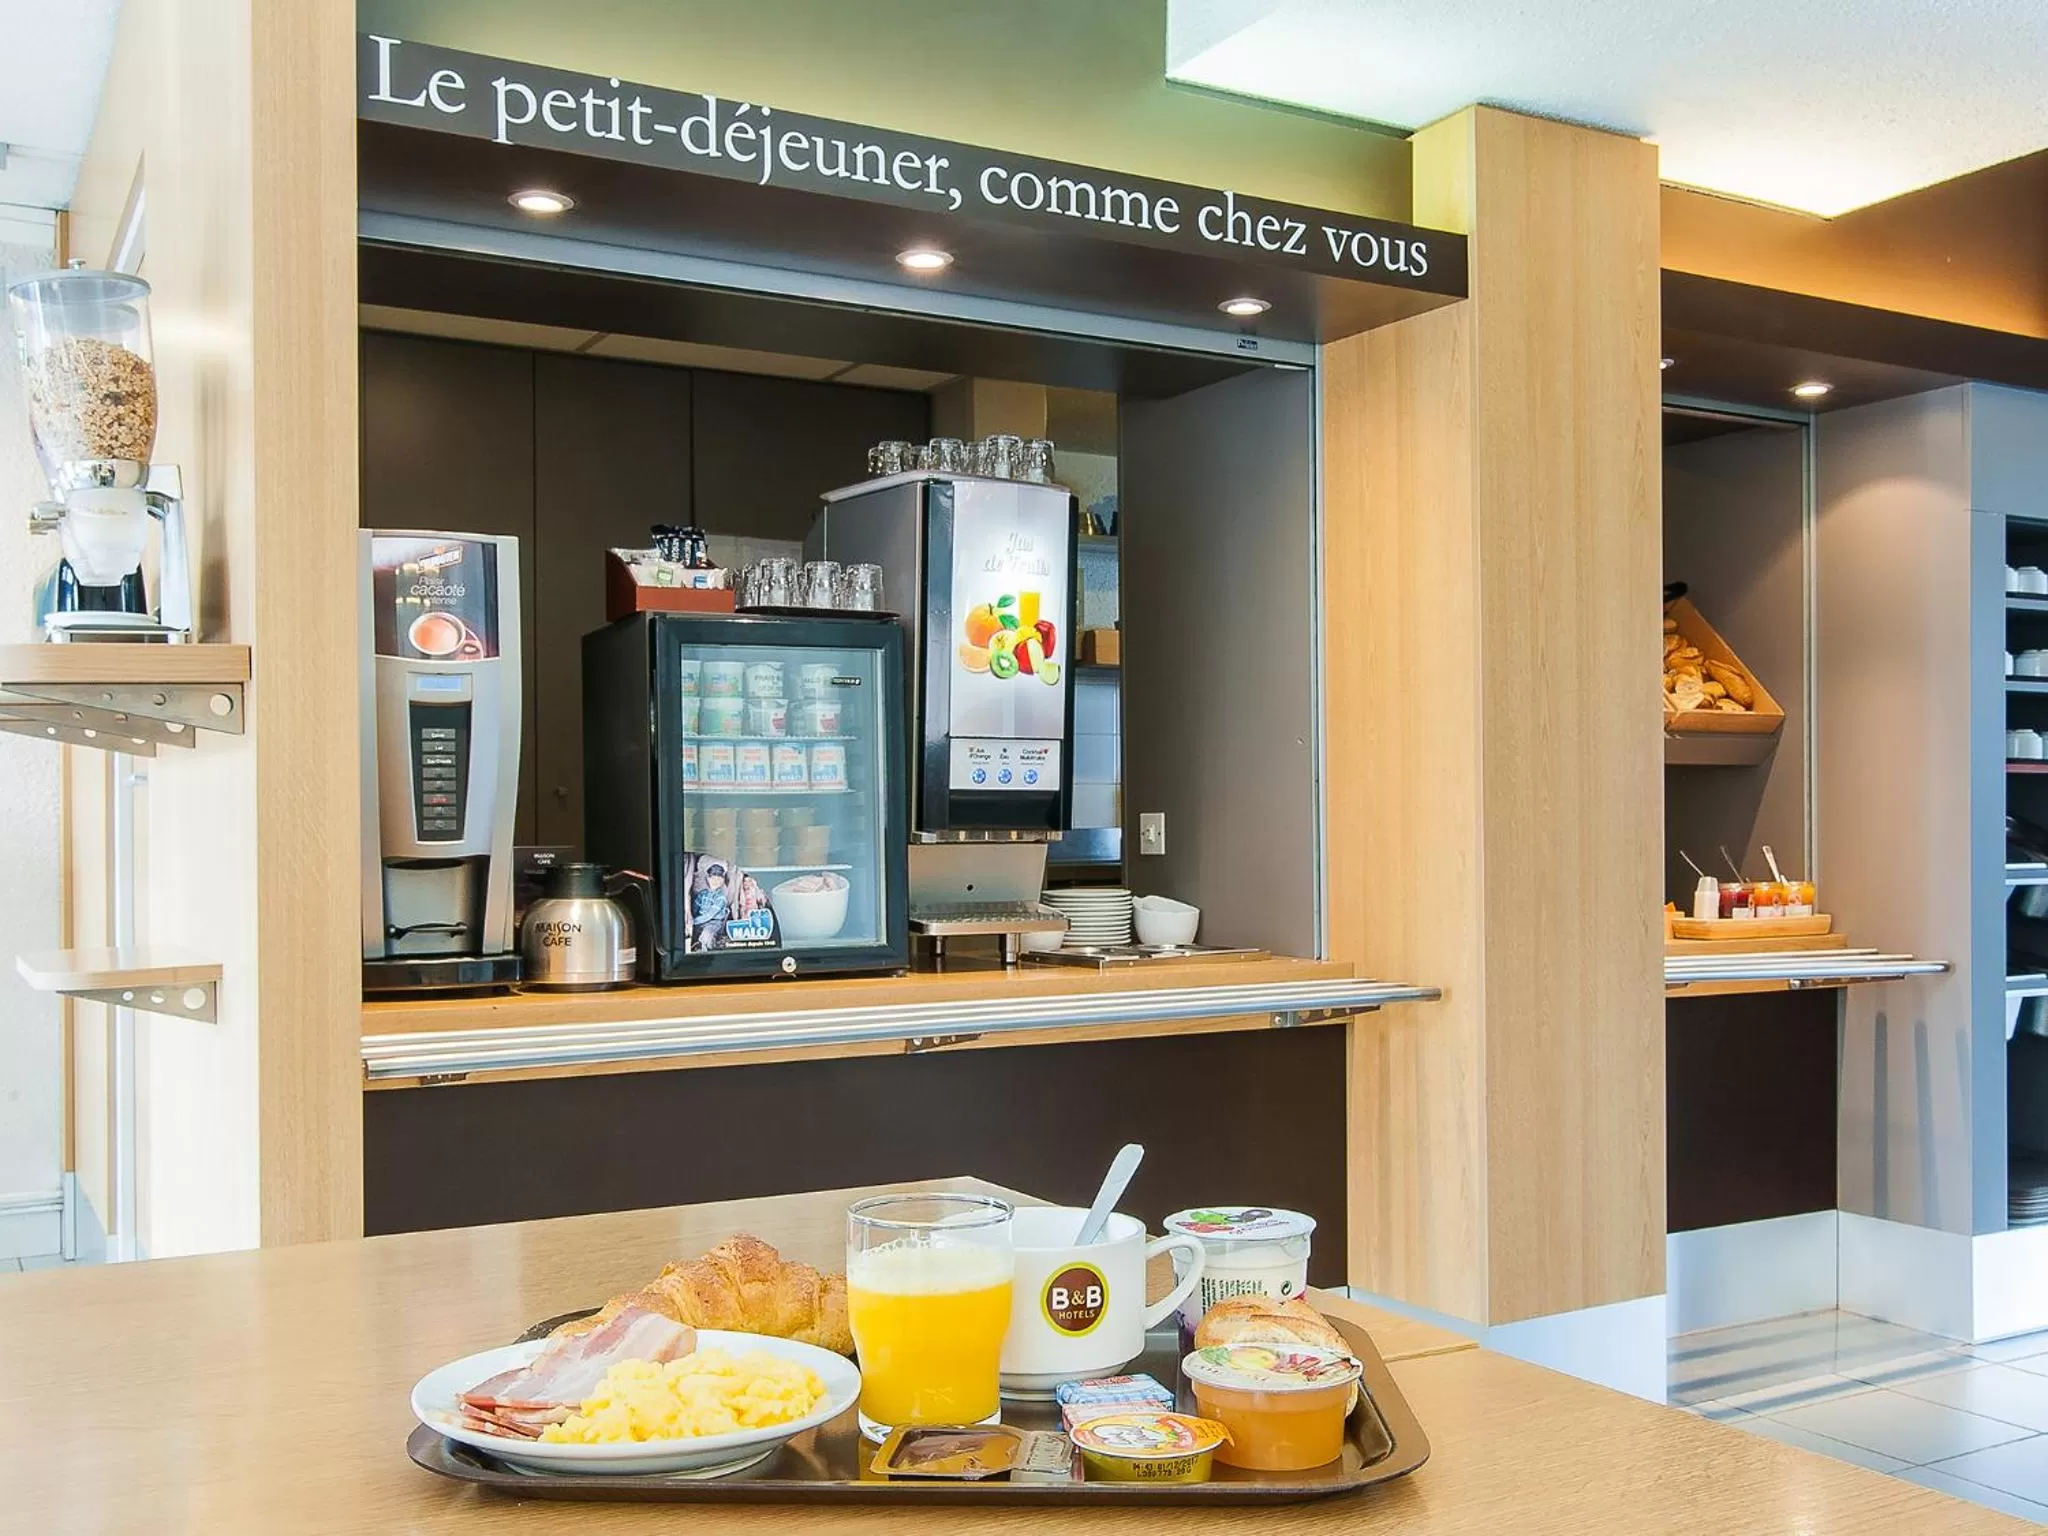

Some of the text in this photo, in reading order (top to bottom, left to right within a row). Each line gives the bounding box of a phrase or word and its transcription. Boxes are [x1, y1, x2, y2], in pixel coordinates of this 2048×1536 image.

[368, 34, 1429, 278] Le petit-déjeuner, comme chez vous
[410, 583, 465, 597] cacaoté
[535, 920, 582, 935] MAISON
[732, 926, 769, 940] MALO
[1051, 1284, 1103, 1311] B&B
[1058, 1309, 1096, 1321] HOTELS
